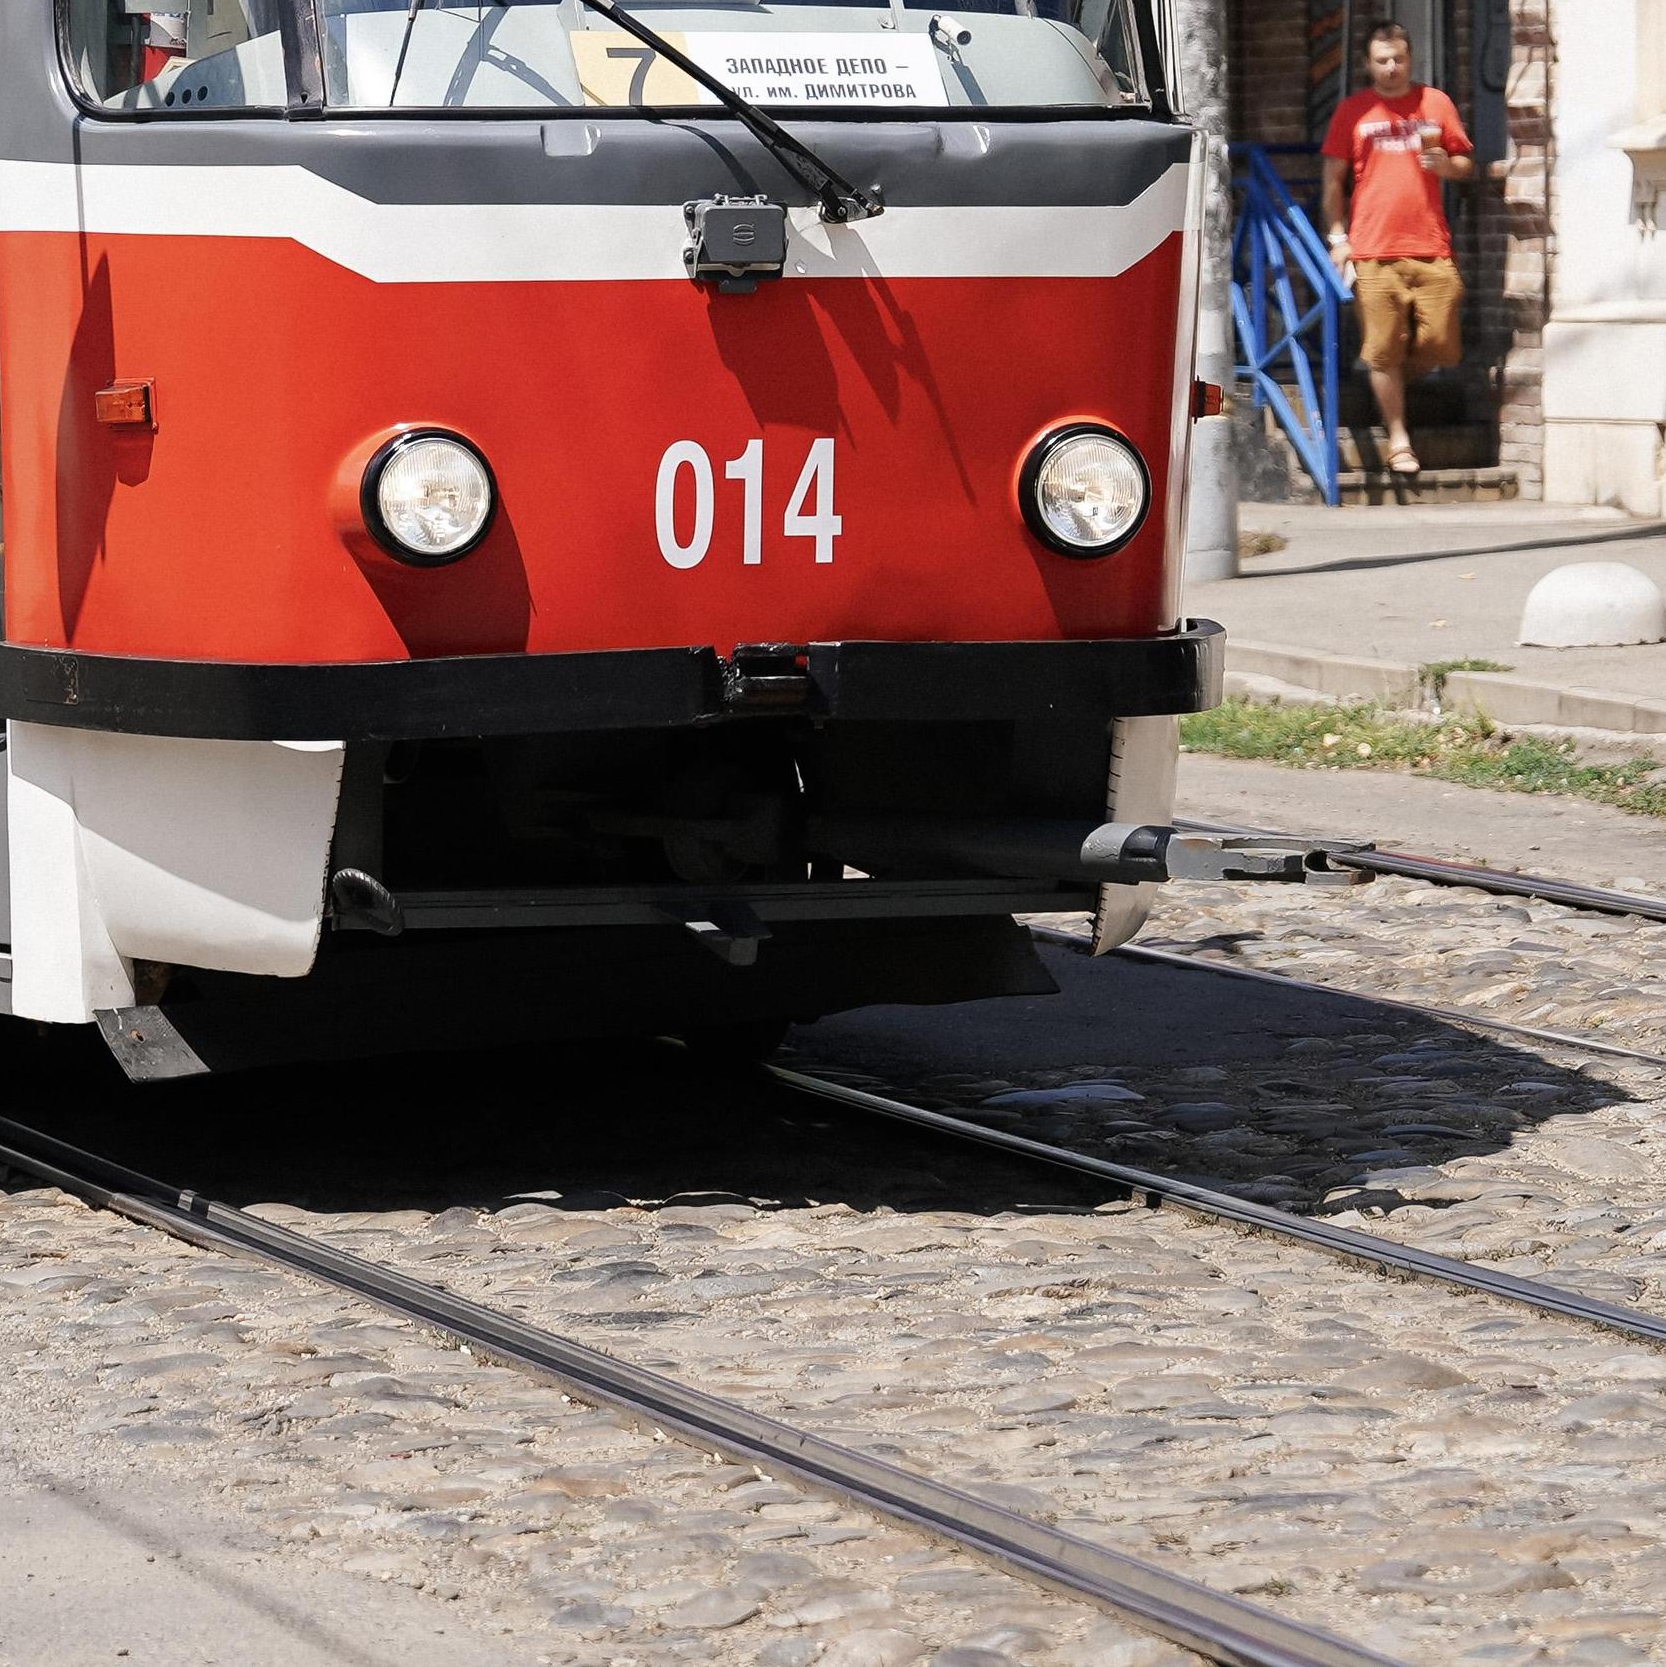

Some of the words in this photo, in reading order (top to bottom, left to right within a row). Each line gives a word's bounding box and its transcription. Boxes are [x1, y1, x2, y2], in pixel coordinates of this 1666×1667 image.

[605, 47, 657, 106] 7
[726, 58, 829, 77] ЗАПАДНОЕ
[835, 58, 888, 77] ДЕПО
[766, 86, 798, 99] им.
[805, 83, 918, 101] ДИМИТРОВА
[654, 437, 843, 570] 014
